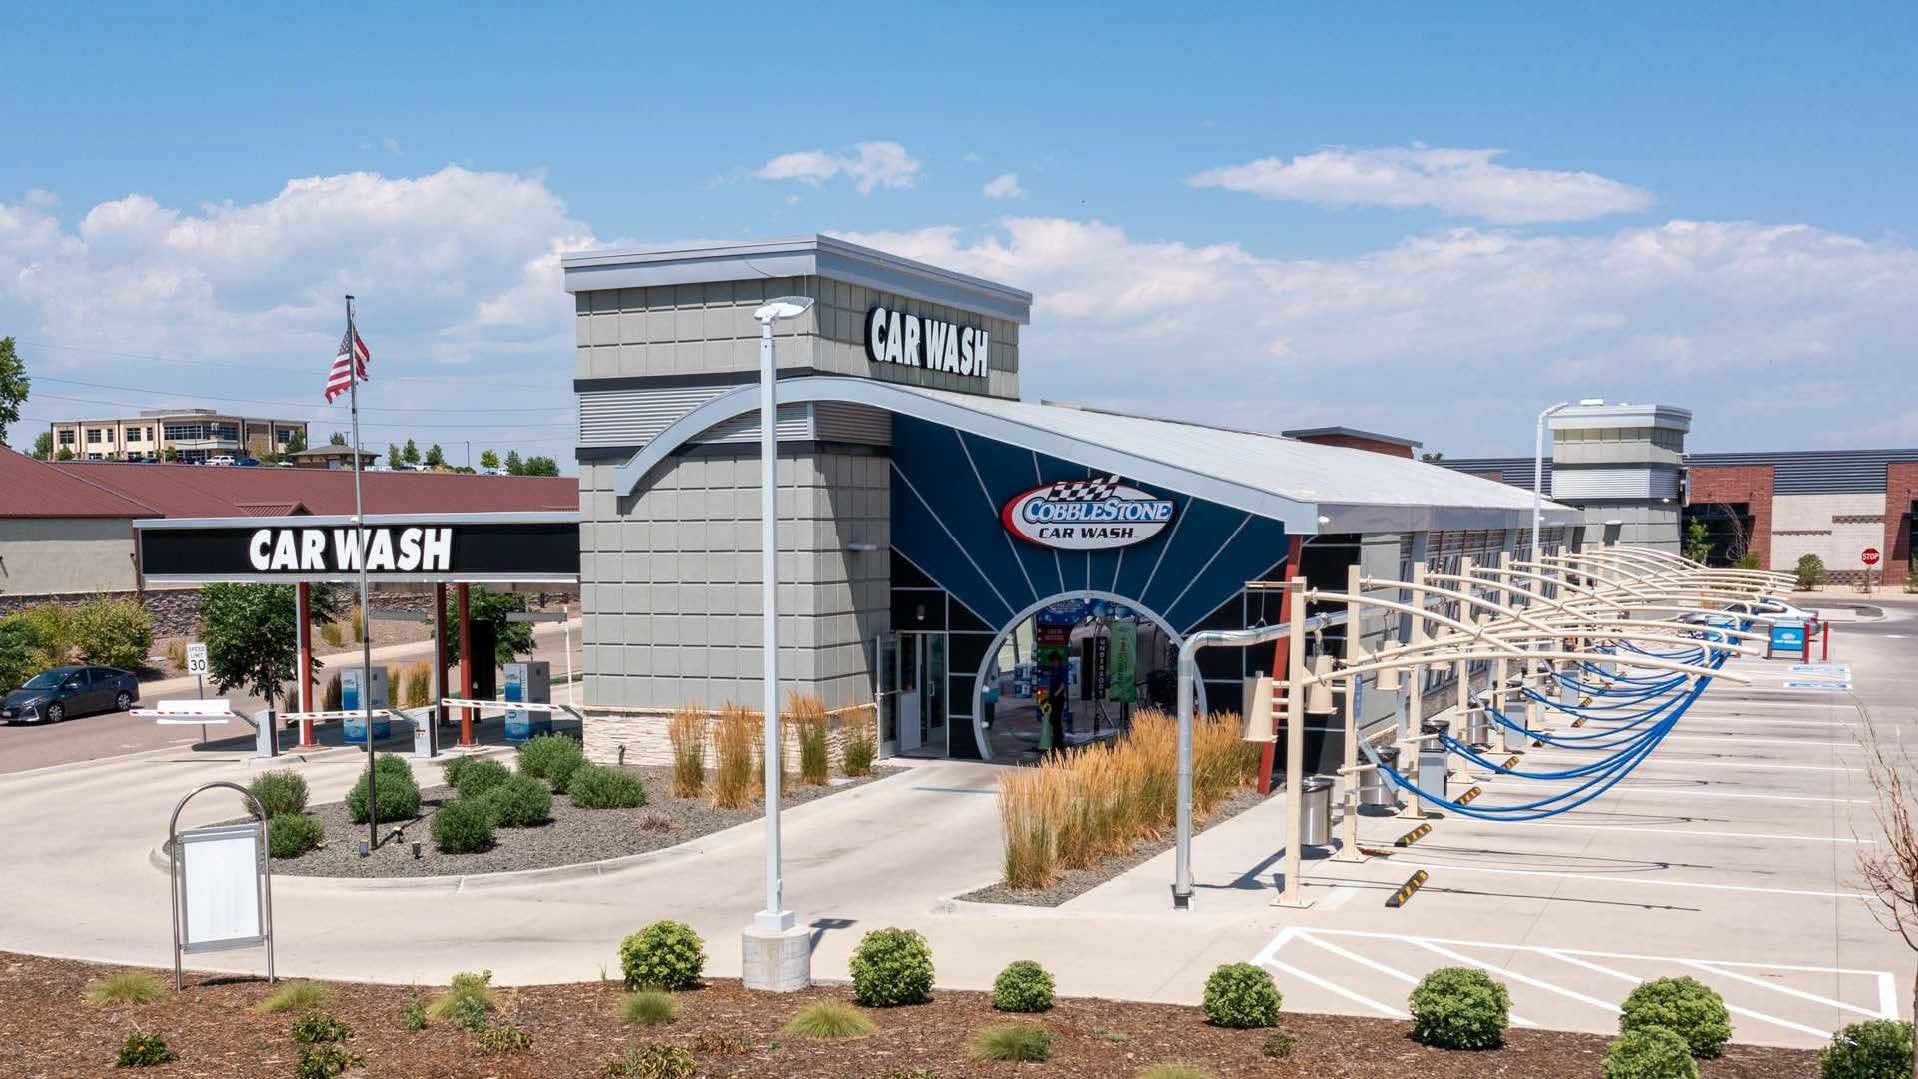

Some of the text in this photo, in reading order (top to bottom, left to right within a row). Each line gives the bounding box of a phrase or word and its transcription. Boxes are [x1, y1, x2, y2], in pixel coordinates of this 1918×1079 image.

[871, 307, 989, 378] CAR WASH
[1026, 498, 1173, 522] COBBLESTONE
[1039, 527, 1134, 539] CAR WASH
[249, 528, 453, 571] CAR WASH
[1862, 552, 1879, 561] STOP
[191, 659, 206, 671] 30
